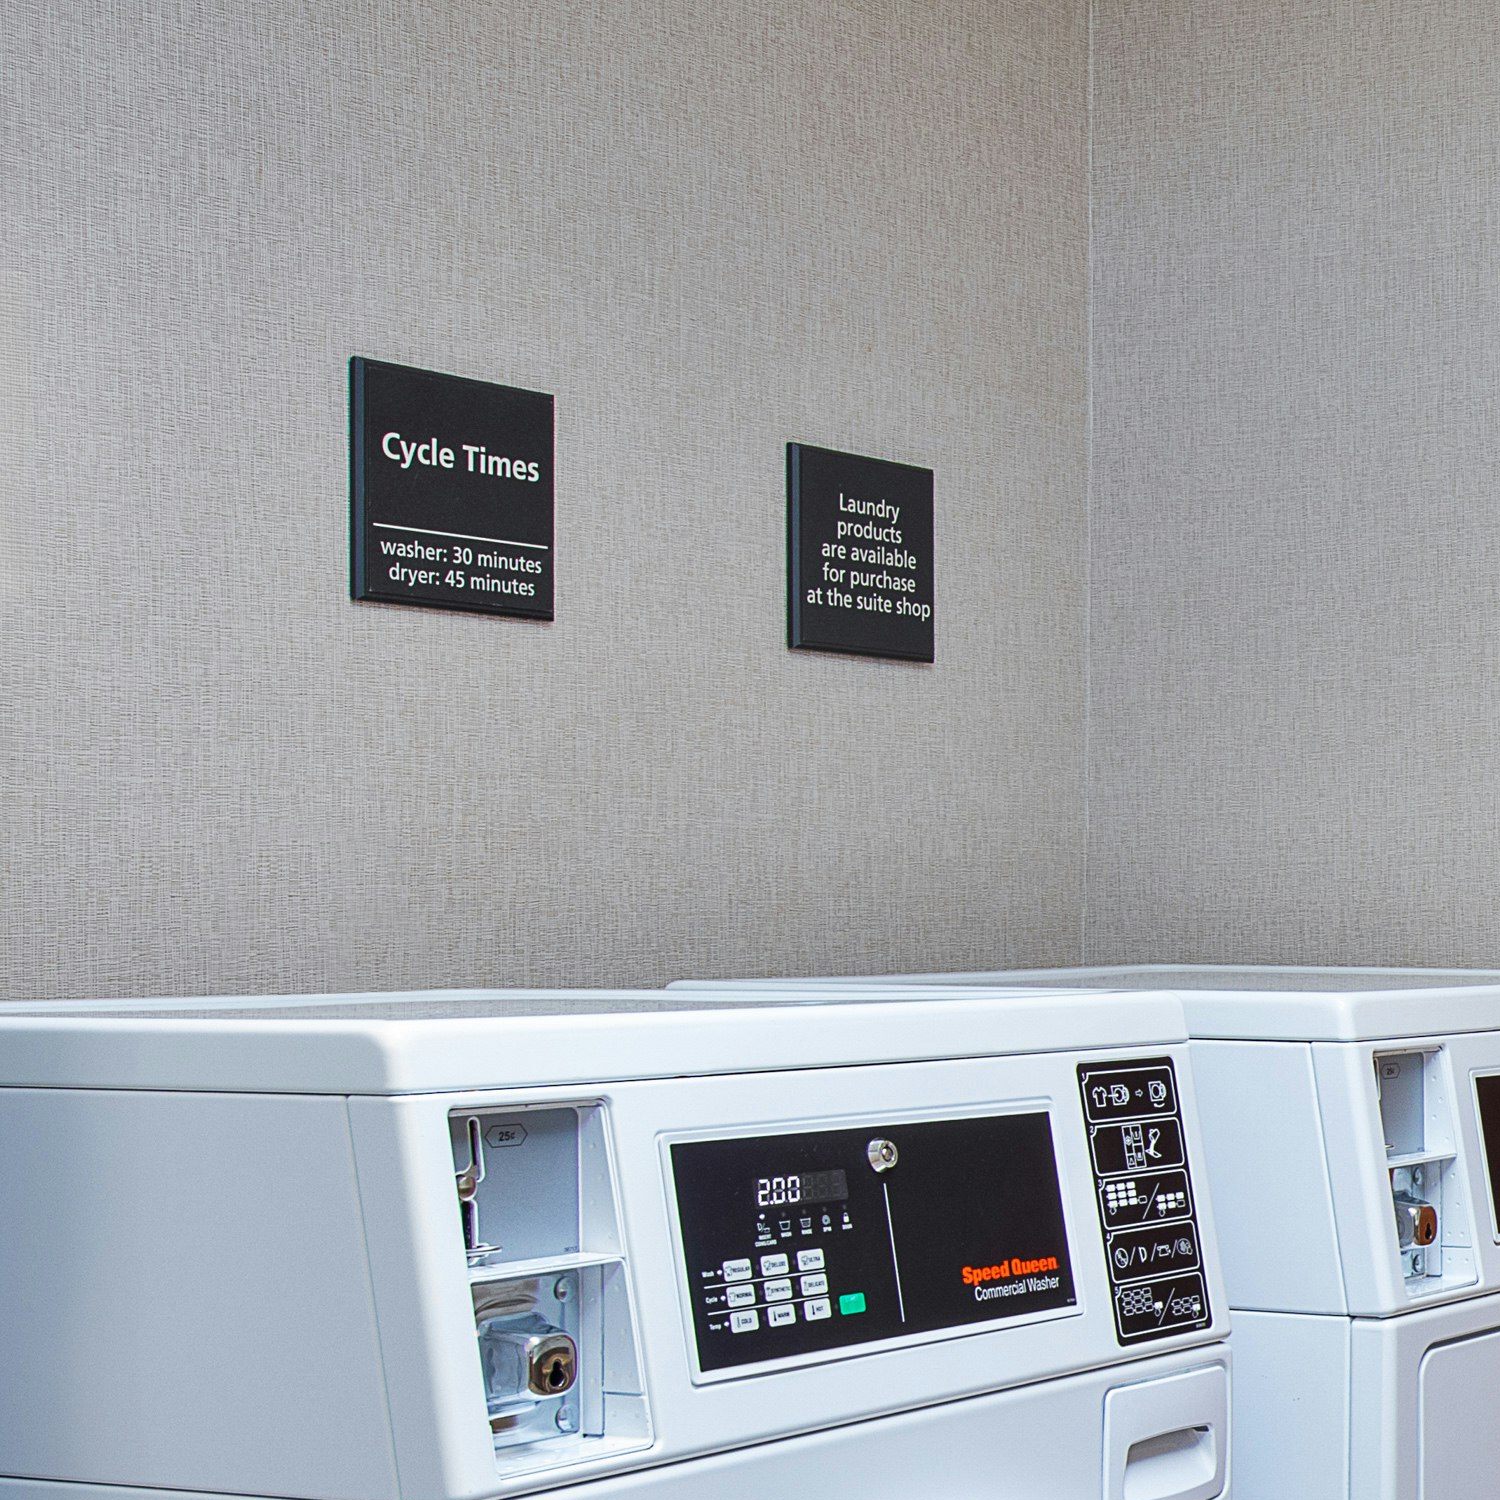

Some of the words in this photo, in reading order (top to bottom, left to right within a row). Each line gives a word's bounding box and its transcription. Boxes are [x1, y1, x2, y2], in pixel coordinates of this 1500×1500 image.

[383, 432, 454, 468] Cycle
[463, 445, 539, 481] Times
[839, 493, 900, 524] Laundry
[837, 521, 902, 543] products
[381, 541, 447, 562] washer:
[453, 547, 472, 565] 30
[478, 551, 542, 574] minutes
[822, 543, 846, 558] are
[851, 546, 916, 569] available
[389, 563, 439, 586] dryer:
[445, 570, 464, 587] 45
[471, 572, 535, 595] minutes
[822, 562, 845, 582] for
[850, 569, 915, 593] purchase
[807, 588, 822, 604] at
[827, 588, 852, 608] the
[857, 593, 892, 613] suite
[897, 597, 930, 621] shop
[498, 1131, 516, 1142] 25¢
[758, 1175, 801, 1207] 2.00
[961, 1260, 1010, 1286] Speed
[1010, 1256, 1059, 1276] Queen
[974, 1279, 1027, 1301] Commercial
[1027, 1275, 1060, 1292] Washer
